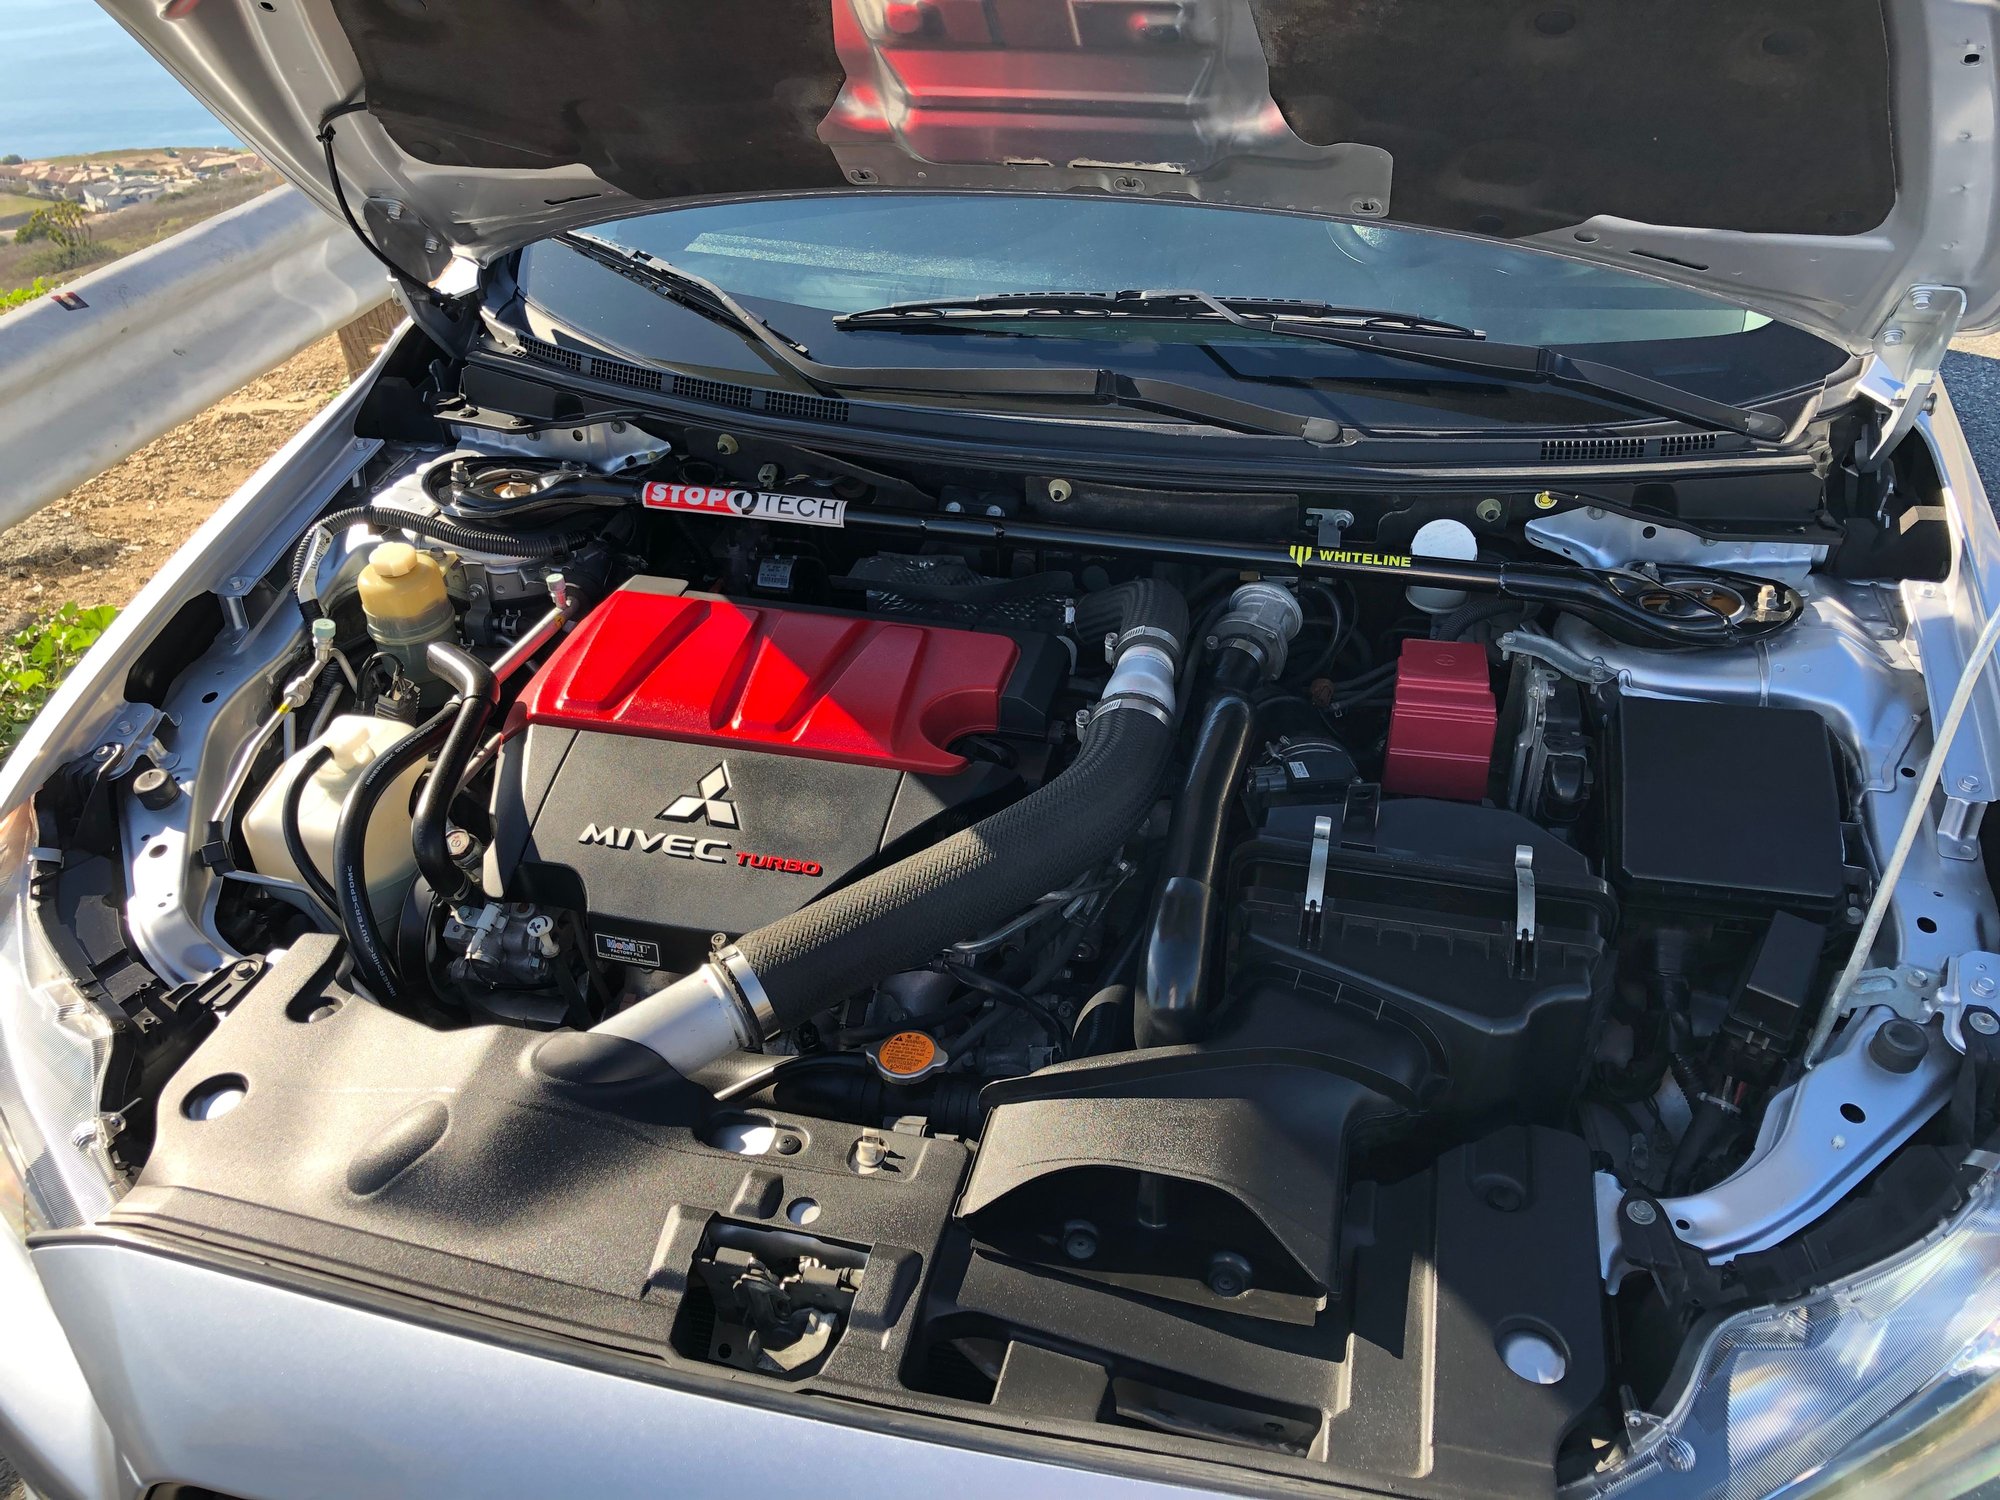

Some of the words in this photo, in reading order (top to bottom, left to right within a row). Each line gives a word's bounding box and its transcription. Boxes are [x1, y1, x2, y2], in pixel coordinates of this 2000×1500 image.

[1319, 550, 1412, 568] WHITELINE
[578, 823, 730, 863] MIVEC
[735, 850, 823, 876] TURBO
[606, 938, 636, 952] Mobil
